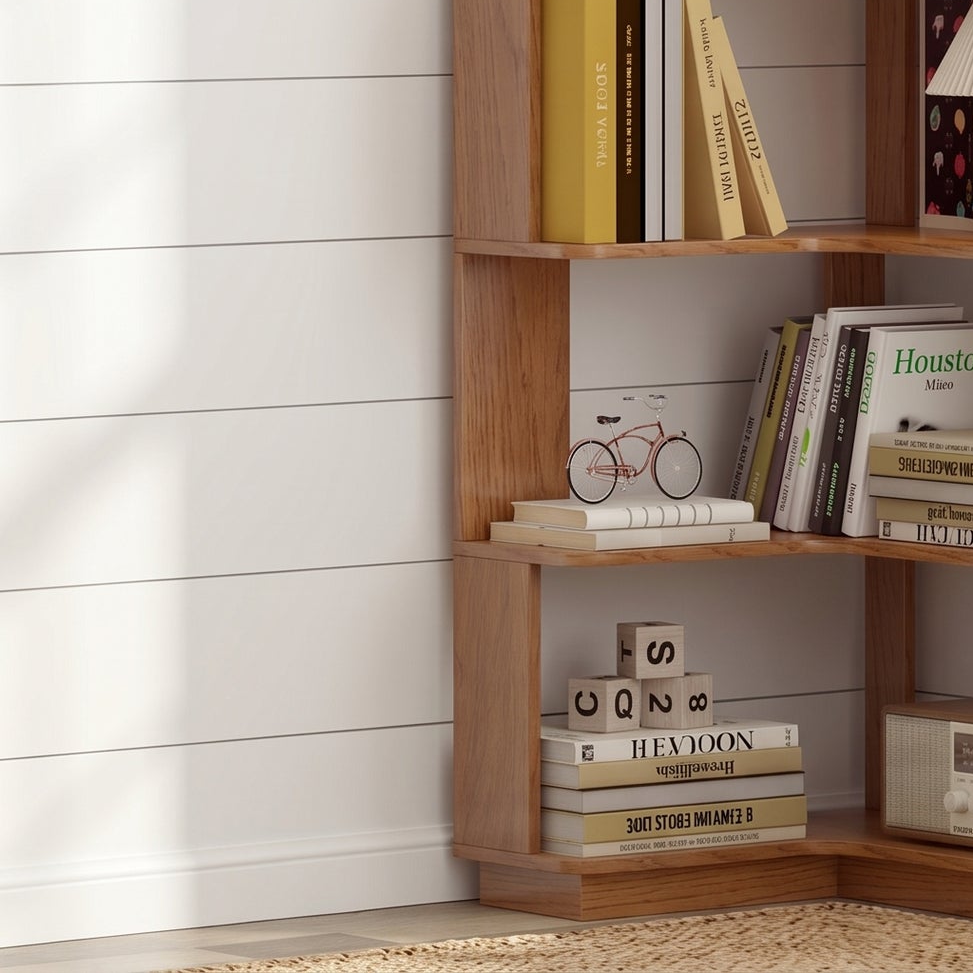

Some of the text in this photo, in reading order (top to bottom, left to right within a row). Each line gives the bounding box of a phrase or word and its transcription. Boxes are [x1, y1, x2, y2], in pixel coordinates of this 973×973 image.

[620, 640, 633, 663] T
[646, 640, 676, 665] S
[574, 691, 599, 717] C
[615, 688, 633, 720] Q
[649, 692, 673, 714] 2
[688, 692, 708, 712] 8
